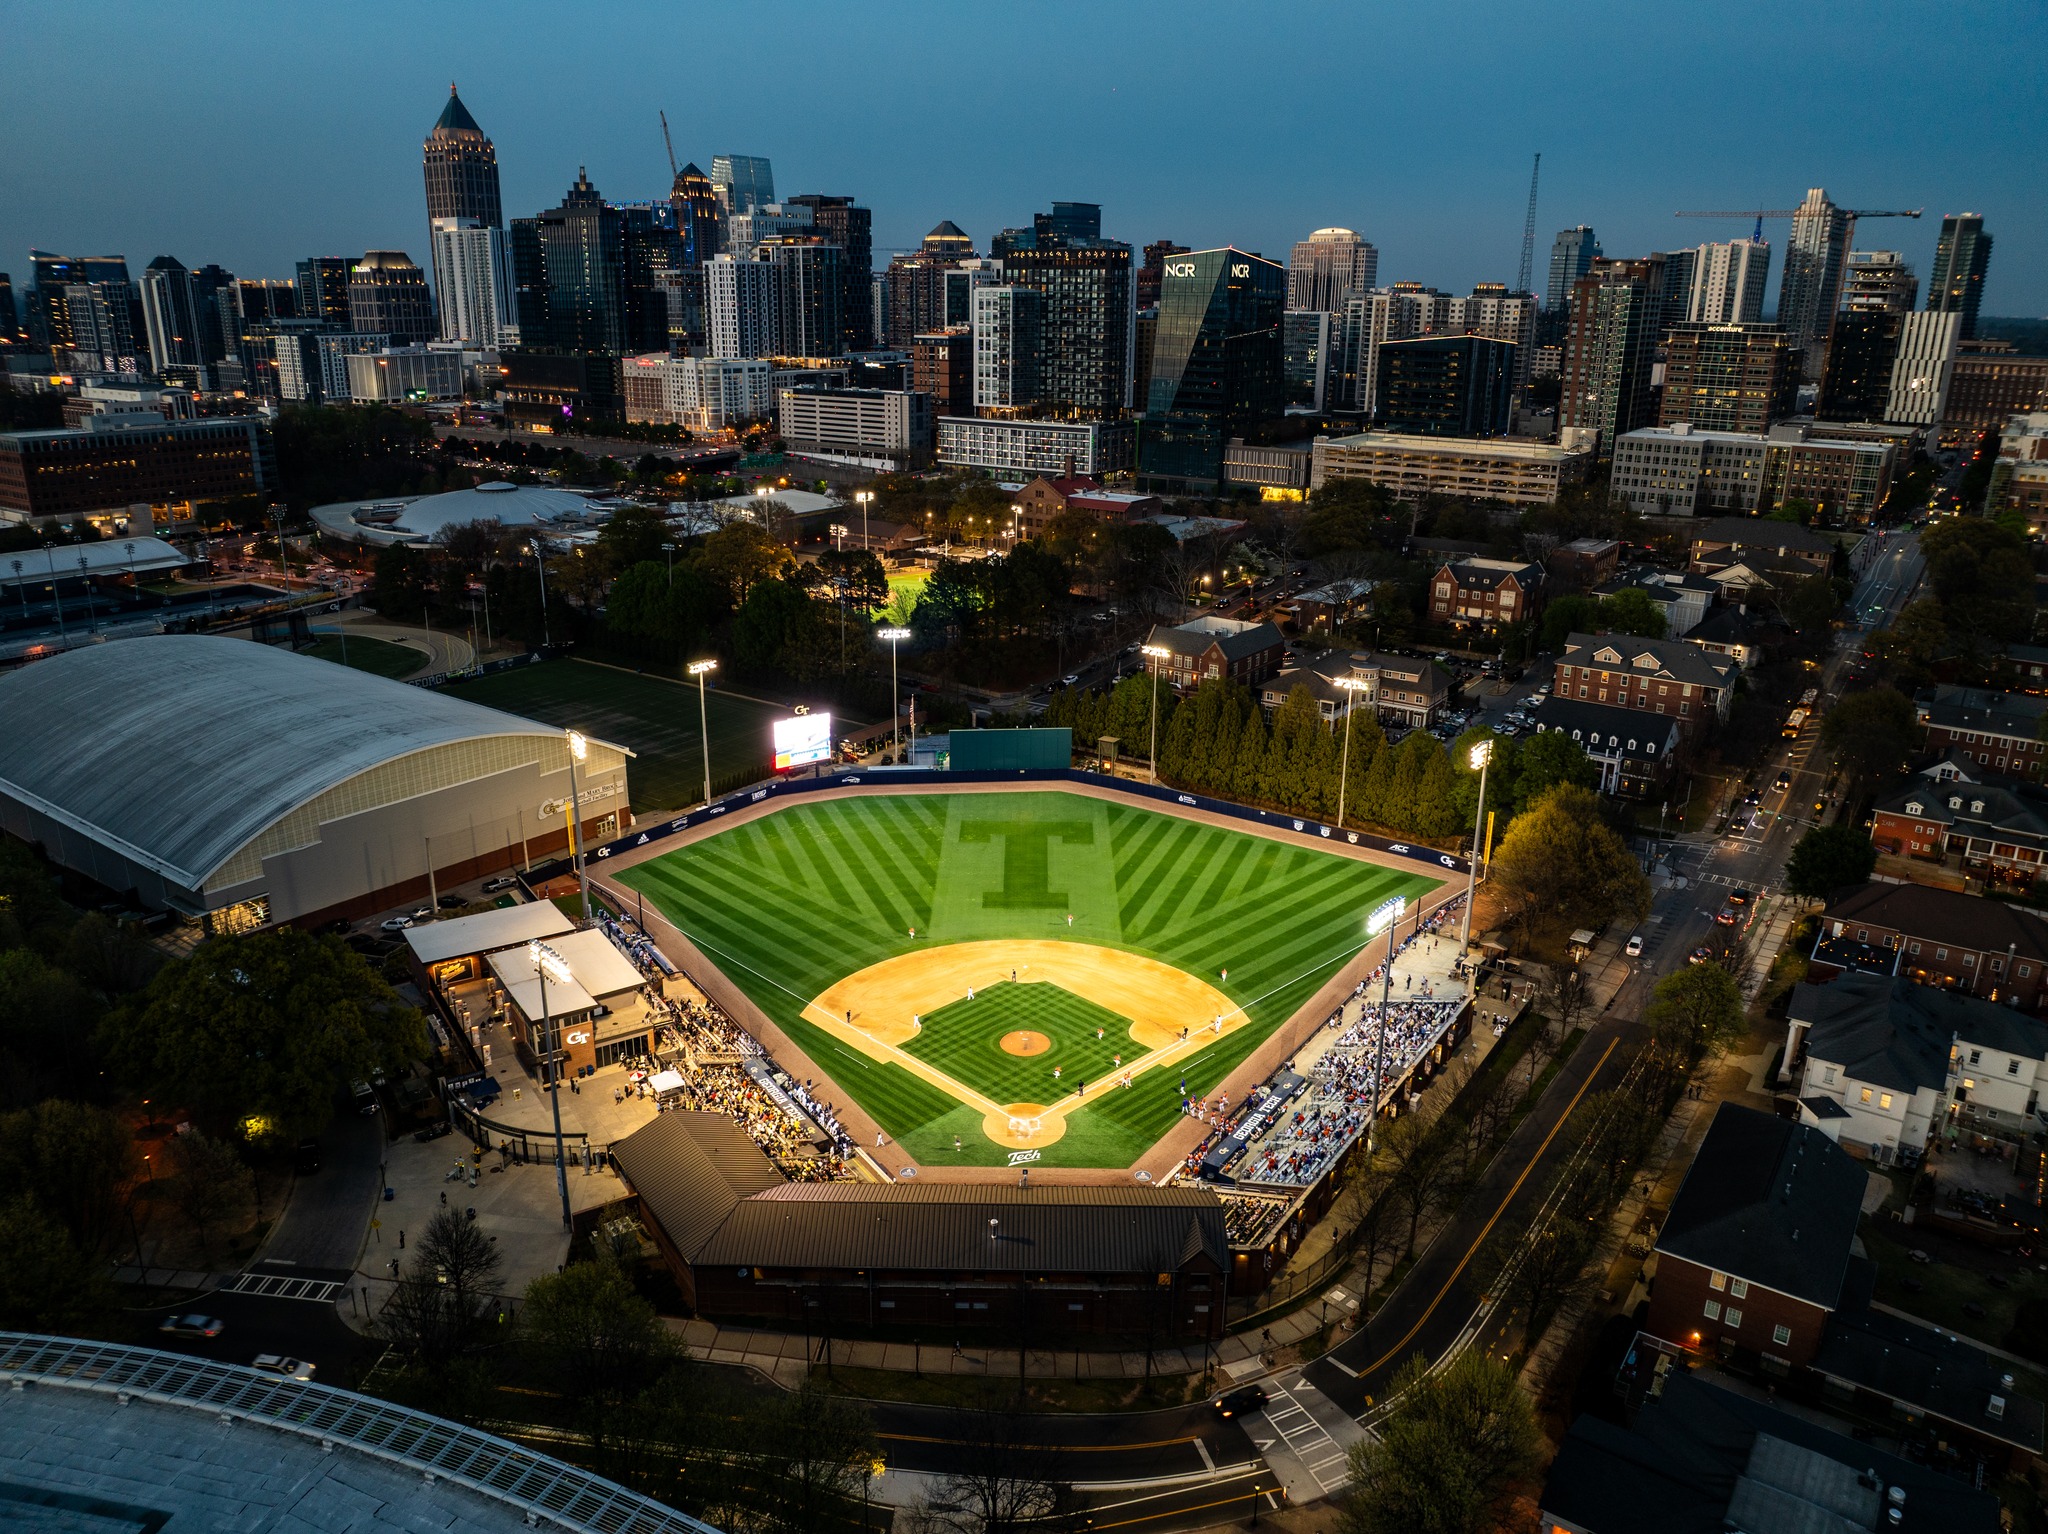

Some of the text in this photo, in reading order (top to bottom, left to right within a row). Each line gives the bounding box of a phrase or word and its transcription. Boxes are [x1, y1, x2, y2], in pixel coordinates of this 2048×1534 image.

[1165, 263, 1196, 278] NCR
[1231, 263, 1250, 279] NCR
[1707, 325, 1744, 333] accenture
[794, 704, 810, 715] GT
[597, 846, 611, 857] GT
[1388, 844, 1410, 852] ACC
[1440, 855, 1455, 868] GT
[566, 1030, 590, 1045] GT
[1233, 1095, 1282, 1141] GEORGIA TECH
[1007, 1149, 1041, 1167] Tech
